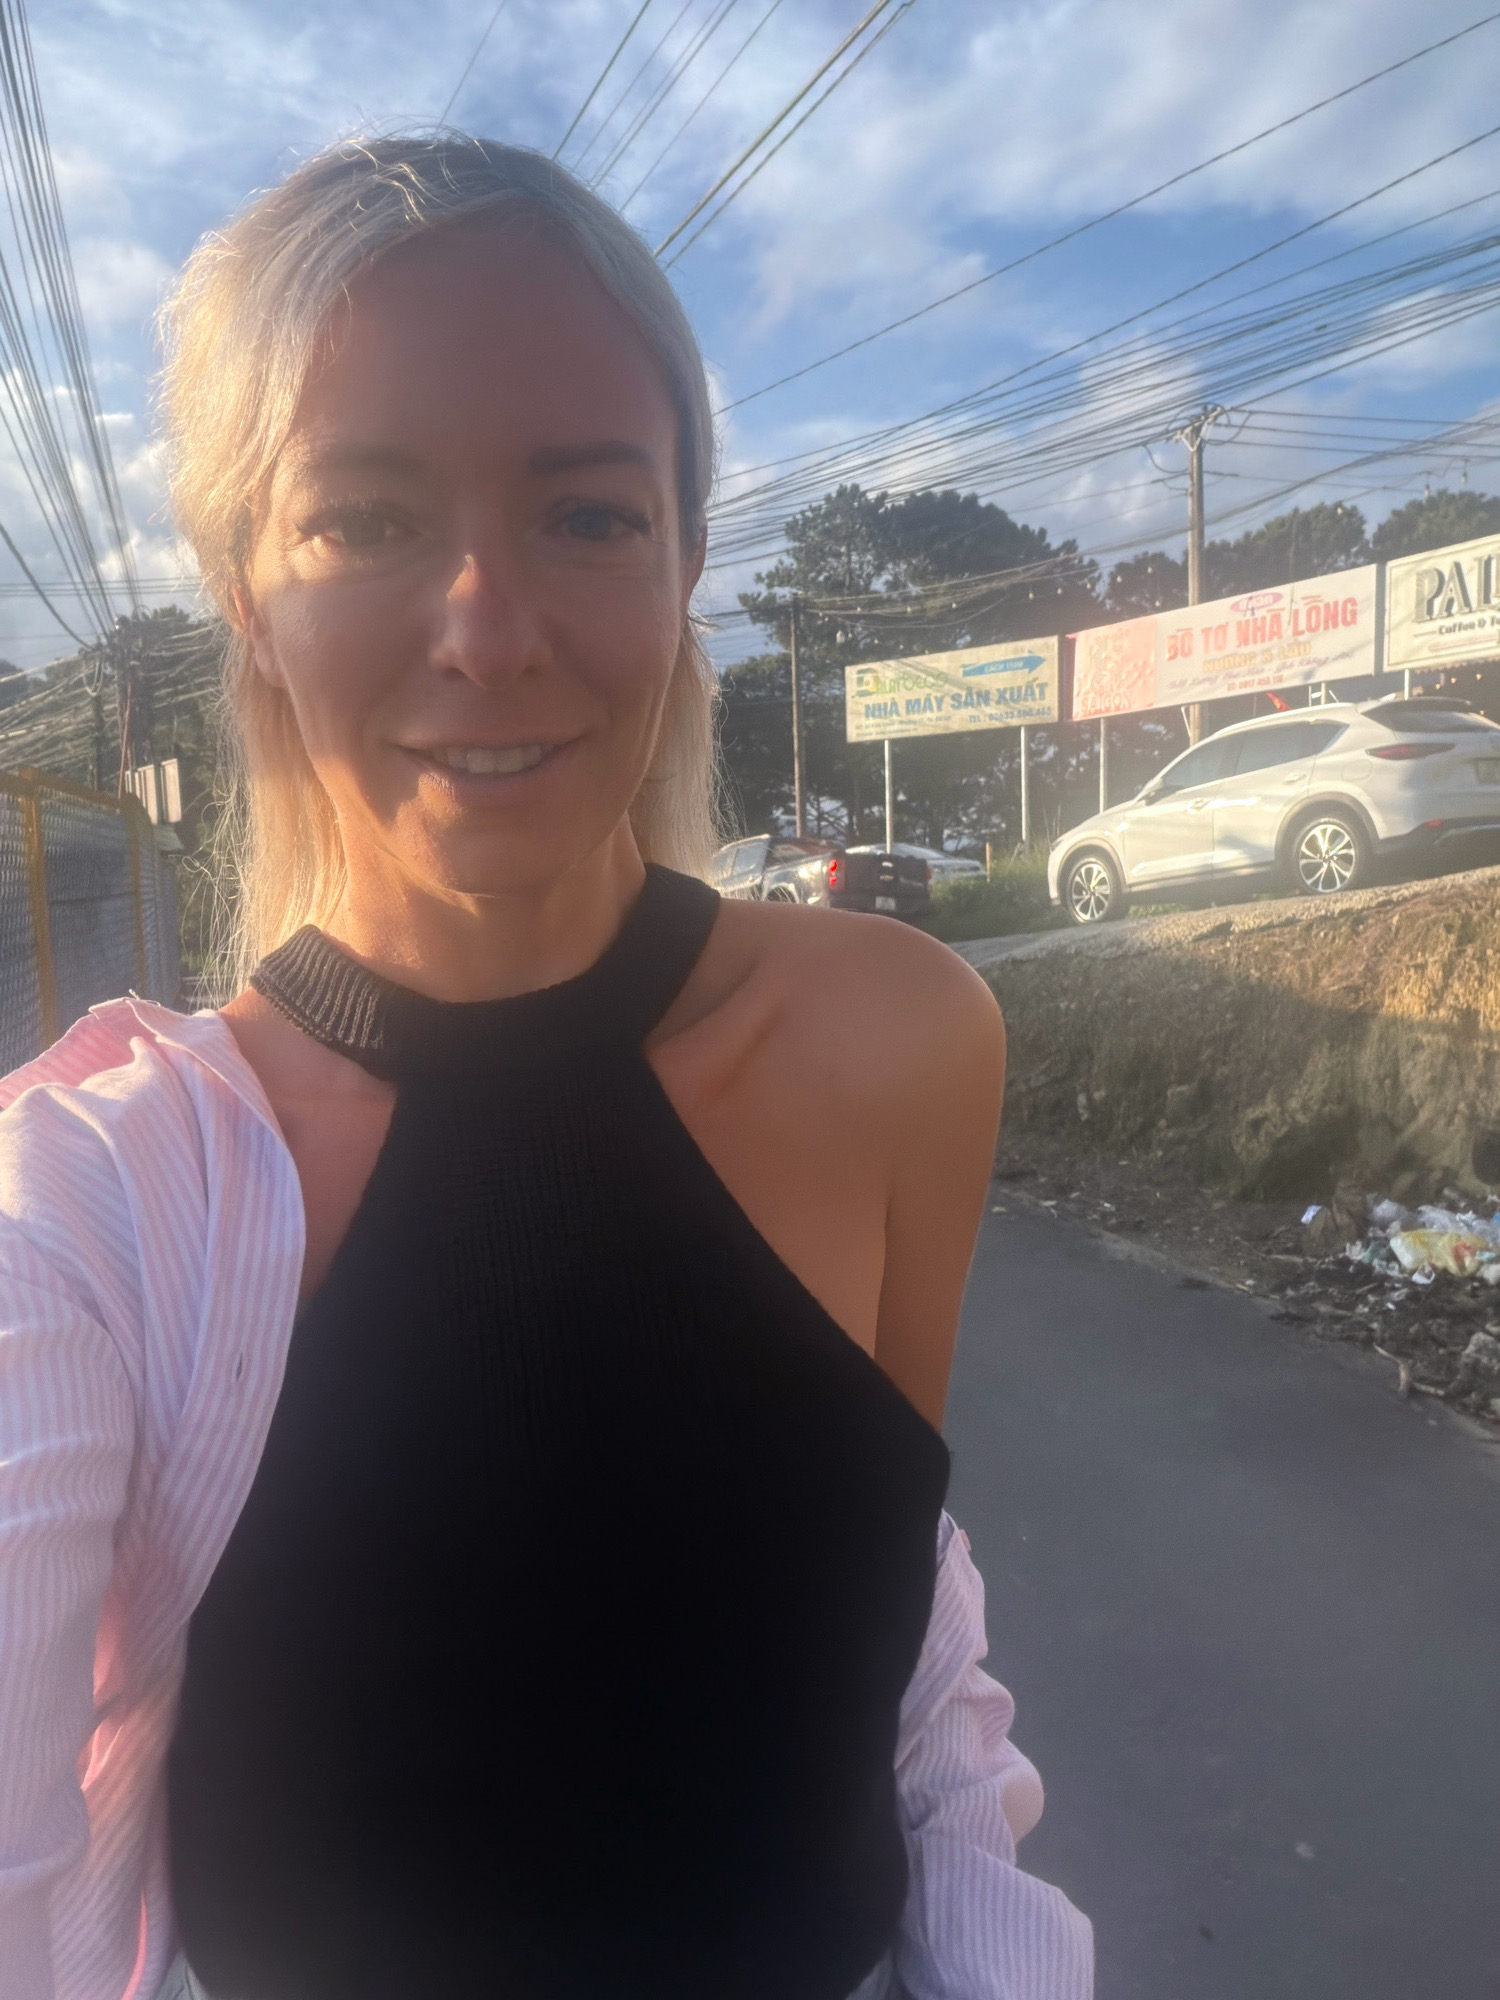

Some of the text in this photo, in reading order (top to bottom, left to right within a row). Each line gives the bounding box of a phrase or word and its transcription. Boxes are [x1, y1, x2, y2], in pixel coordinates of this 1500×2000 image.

[864, 677, 1049, 719] NHÀ MÁY SẢN XUẤT
[1081, 691, 1132, 716] SAIGON
